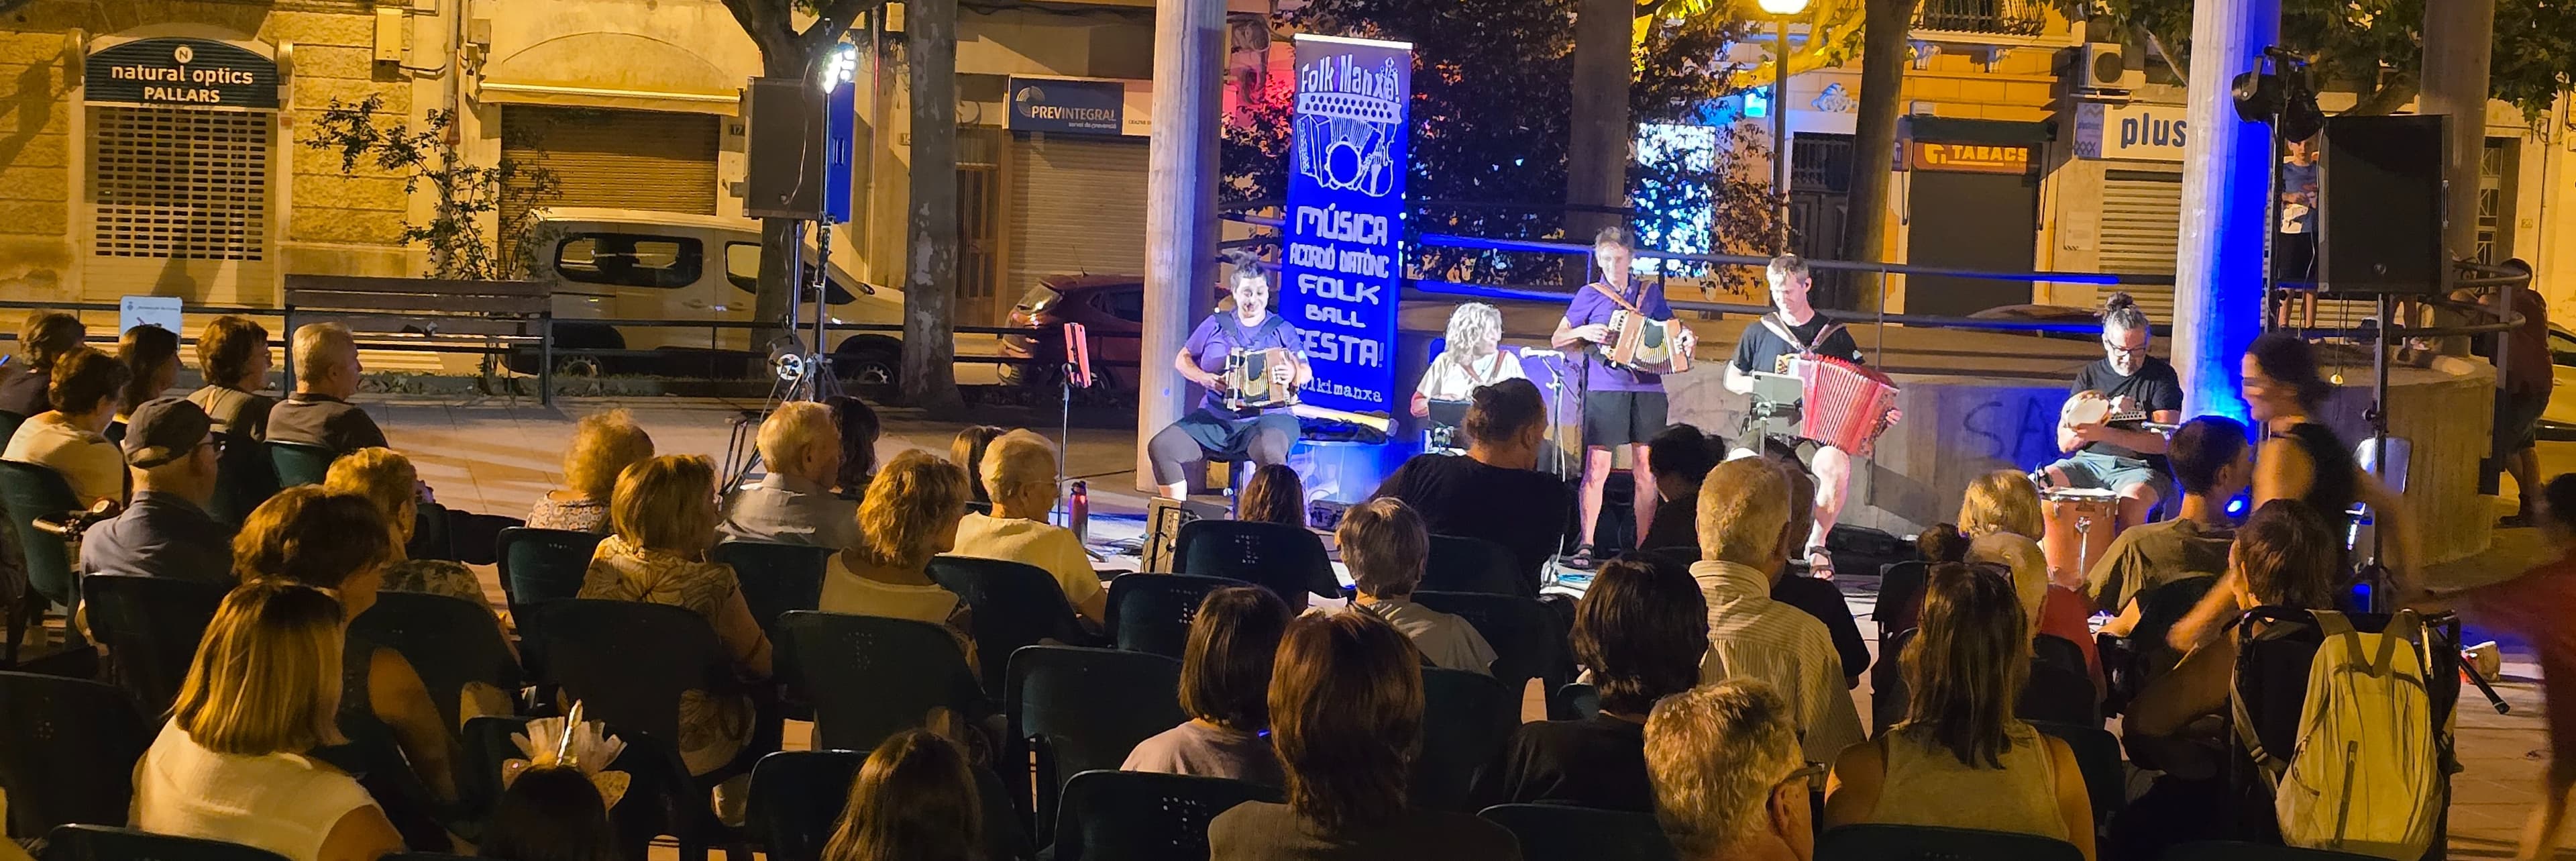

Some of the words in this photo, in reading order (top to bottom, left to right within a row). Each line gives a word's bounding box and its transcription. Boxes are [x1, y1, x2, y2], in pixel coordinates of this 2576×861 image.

[111, 64, 186, 82] natural
[193, 67, 254, 87] optics
[1301, 56, 1335, 93] Folk
[144, 86, 221, 103] PALLARS
[1031, 105, 1117, 121] PREVINTEGRAL
[2120, 112, 2187, 150] plus
[1951, 144, 2028, 162] TABACS
[1295, 203, 1388, 246] MÚSICA
[1297, 273, 1381, 305] FOLK
[1305, 303, 1366, 328] BALL
[1298, 375, 1383, 403] olkimanxa
